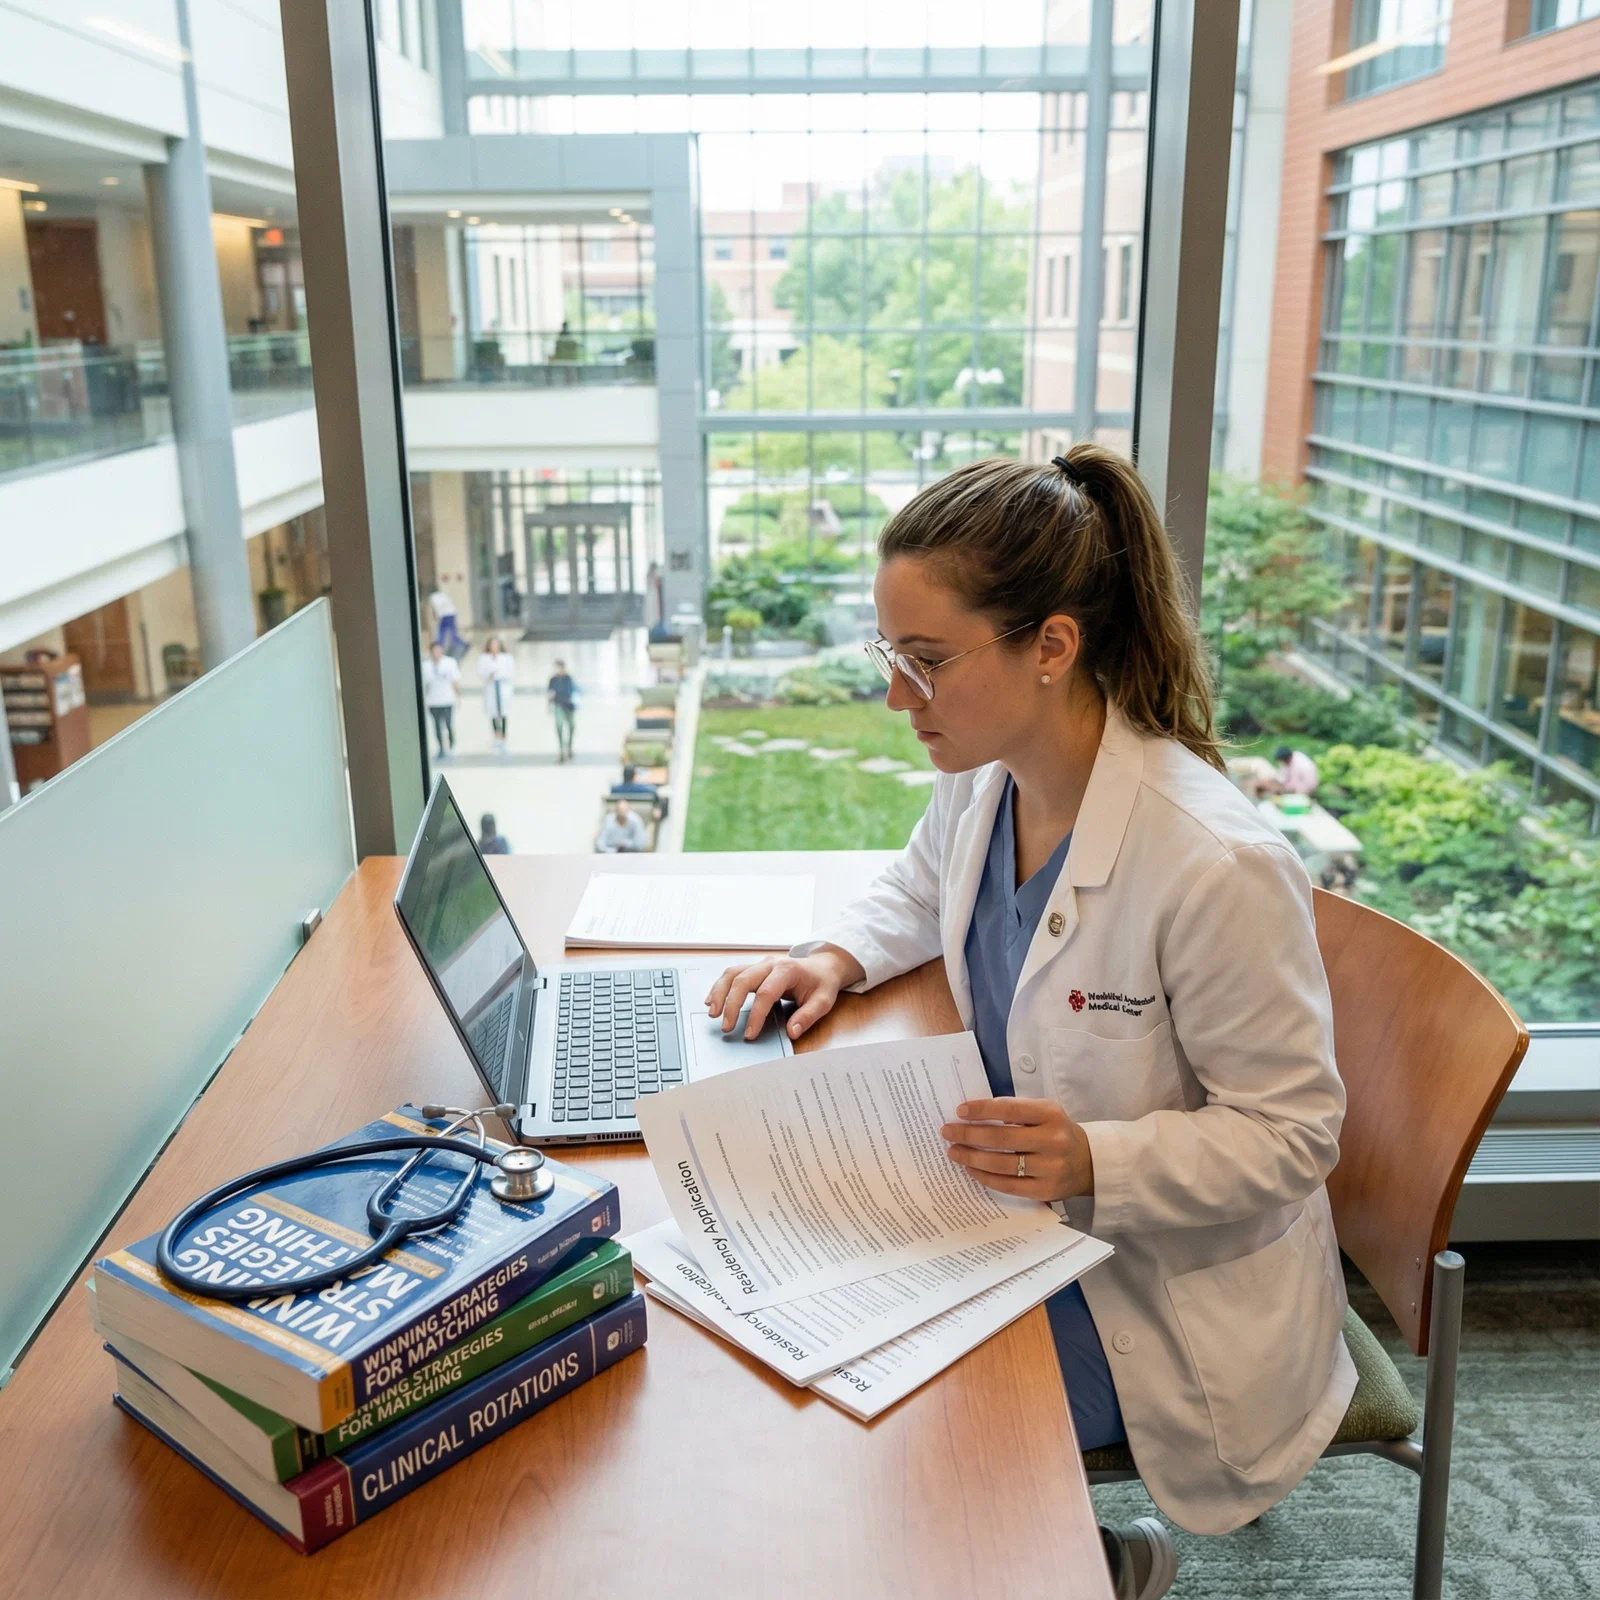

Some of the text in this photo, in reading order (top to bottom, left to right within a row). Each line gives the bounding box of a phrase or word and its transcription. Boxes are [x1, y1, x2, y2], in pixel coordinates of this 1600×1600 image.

[677, 1160, 758, 1294] Residency Application
[176, 1248, 357, 1349] WINING
[363, 1314, 439, 1375] WINNING
[441, 1254, 529, 1325] STRATEGIES
[365, 1358, 402, 1396] FOR
[408, 1293, 499, 1368] MATCHING
[338, 1412, 373, 1442] FOR
[377, 1365, 463, 1422] MATCHING
[412, 1327, 504, 1387] STRATEGIES
[362, 1352, 580, 1501] CLINICAL ROTATIONS
